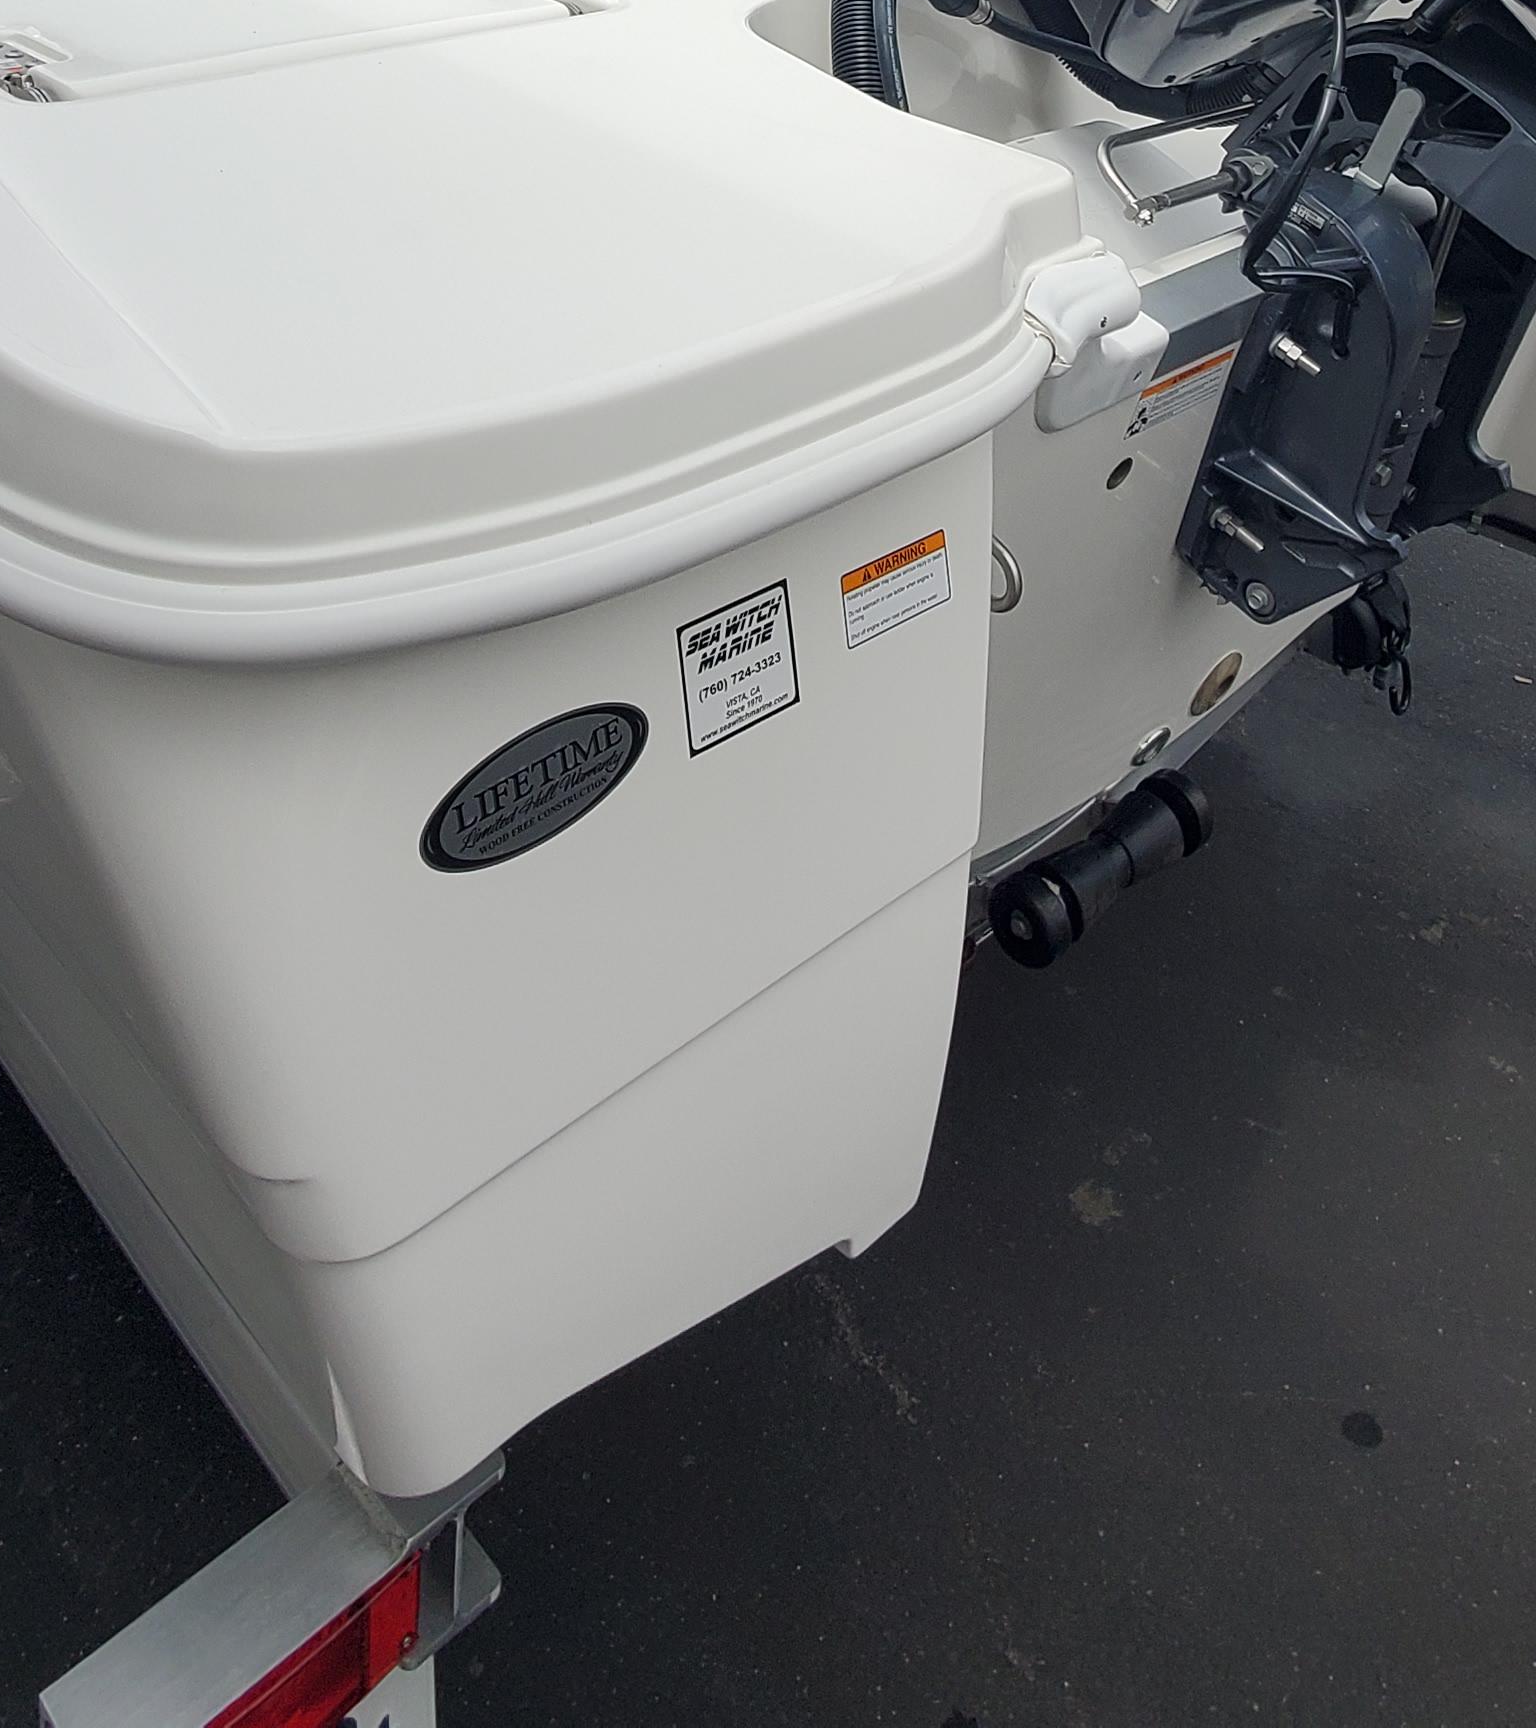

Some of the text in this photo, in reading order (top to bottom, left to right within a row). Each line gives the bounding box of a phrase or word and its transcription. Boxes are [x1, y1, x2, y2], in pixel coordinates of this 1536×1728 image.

[874, 542, 926, 575] WARNING
[685, 595, 782, 657] SEA WITCH
[698, 620, 775, 674] MARINE
[698, 652, 781, 703] (760) 724-3323
[750, 686, 761, 699] CA
[726, 694, 763, 719] Since 1970
[452, 718, 623, 834] LIFETIME
[460, 807, 518, 853] Limited
[479, 777, 608, 855] WOOD FREE CONSTRUCTION
